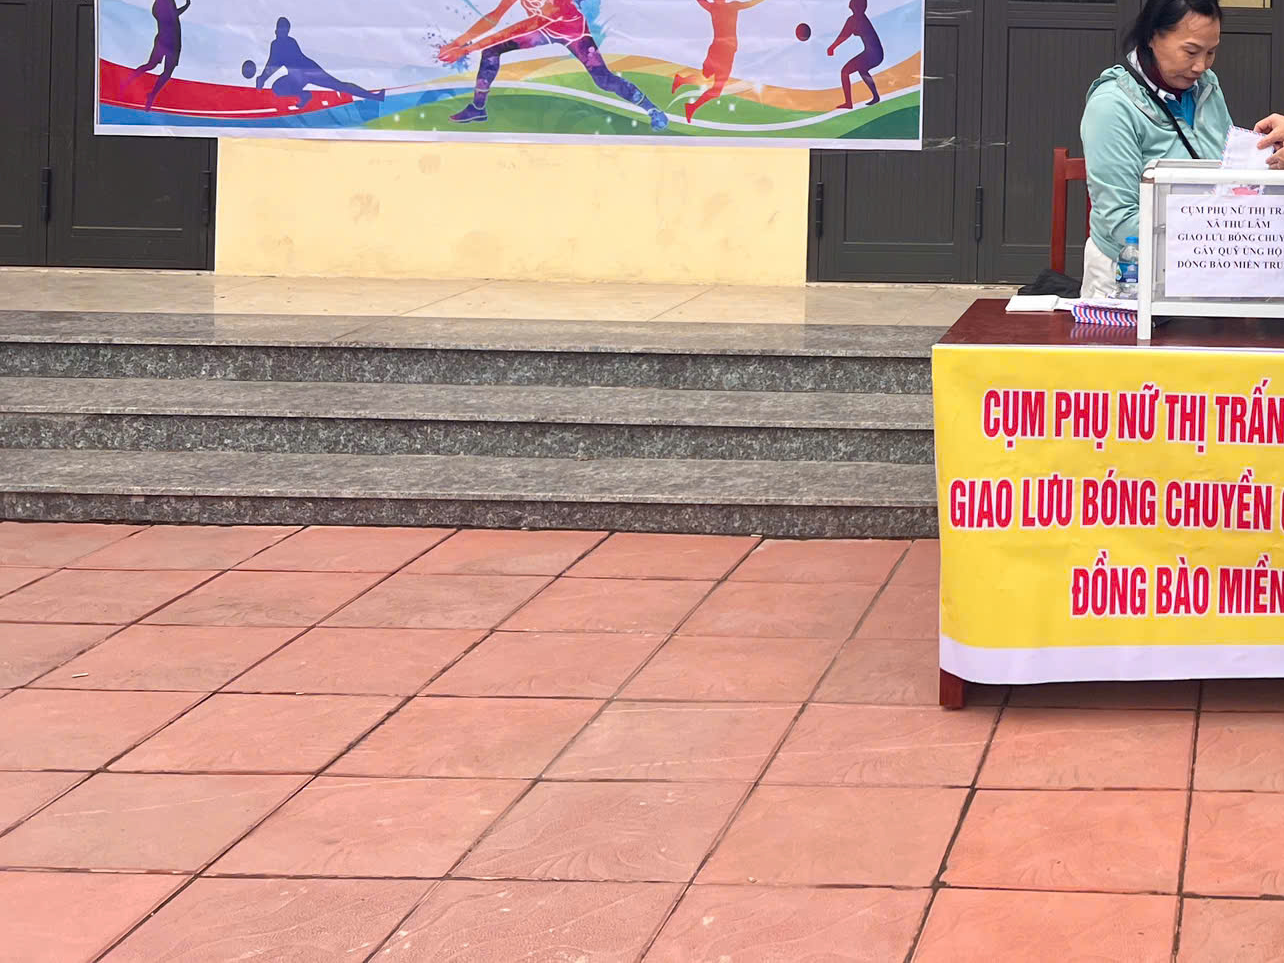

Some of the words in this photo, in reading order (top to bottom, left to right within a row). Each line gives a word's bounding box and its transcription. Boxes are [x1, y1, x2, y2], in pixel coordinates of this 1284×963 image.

[1180, 205, 1204, 217] CỤM
[1207, 205, 1227, 217] PHỤ
[1248, 206, 1265, 217] THỊ
[1206, 218, 1220, 229] XÃ
[1247, 218, 1270, 229] LÂM
[1177, 233, 1203, 242] GIAO
[1228, 232, 1256, 242] BÓNG
[1193, 244, 1215, 255] GÂY
[1267, 246, 1283, 258] HỘ
[983, 389, 1045, 450] CỤM
[1054, 390, 1109, 450] PHỤ
[1117, 382, 1161, 441] NỮ
[1164, 394, 1207, 454] THỊ
[950, 478, 1012, 529] GIAO
[1021, 473, 1073, 528] LƯU
[1082, 469, 1157, 527] BÓNG
[1165, 467, 1272, 532] CHUYỀN
[1071, 549, 1147, 617] ĐỒNG
[1155, 556, 1209, 615] BÀO
